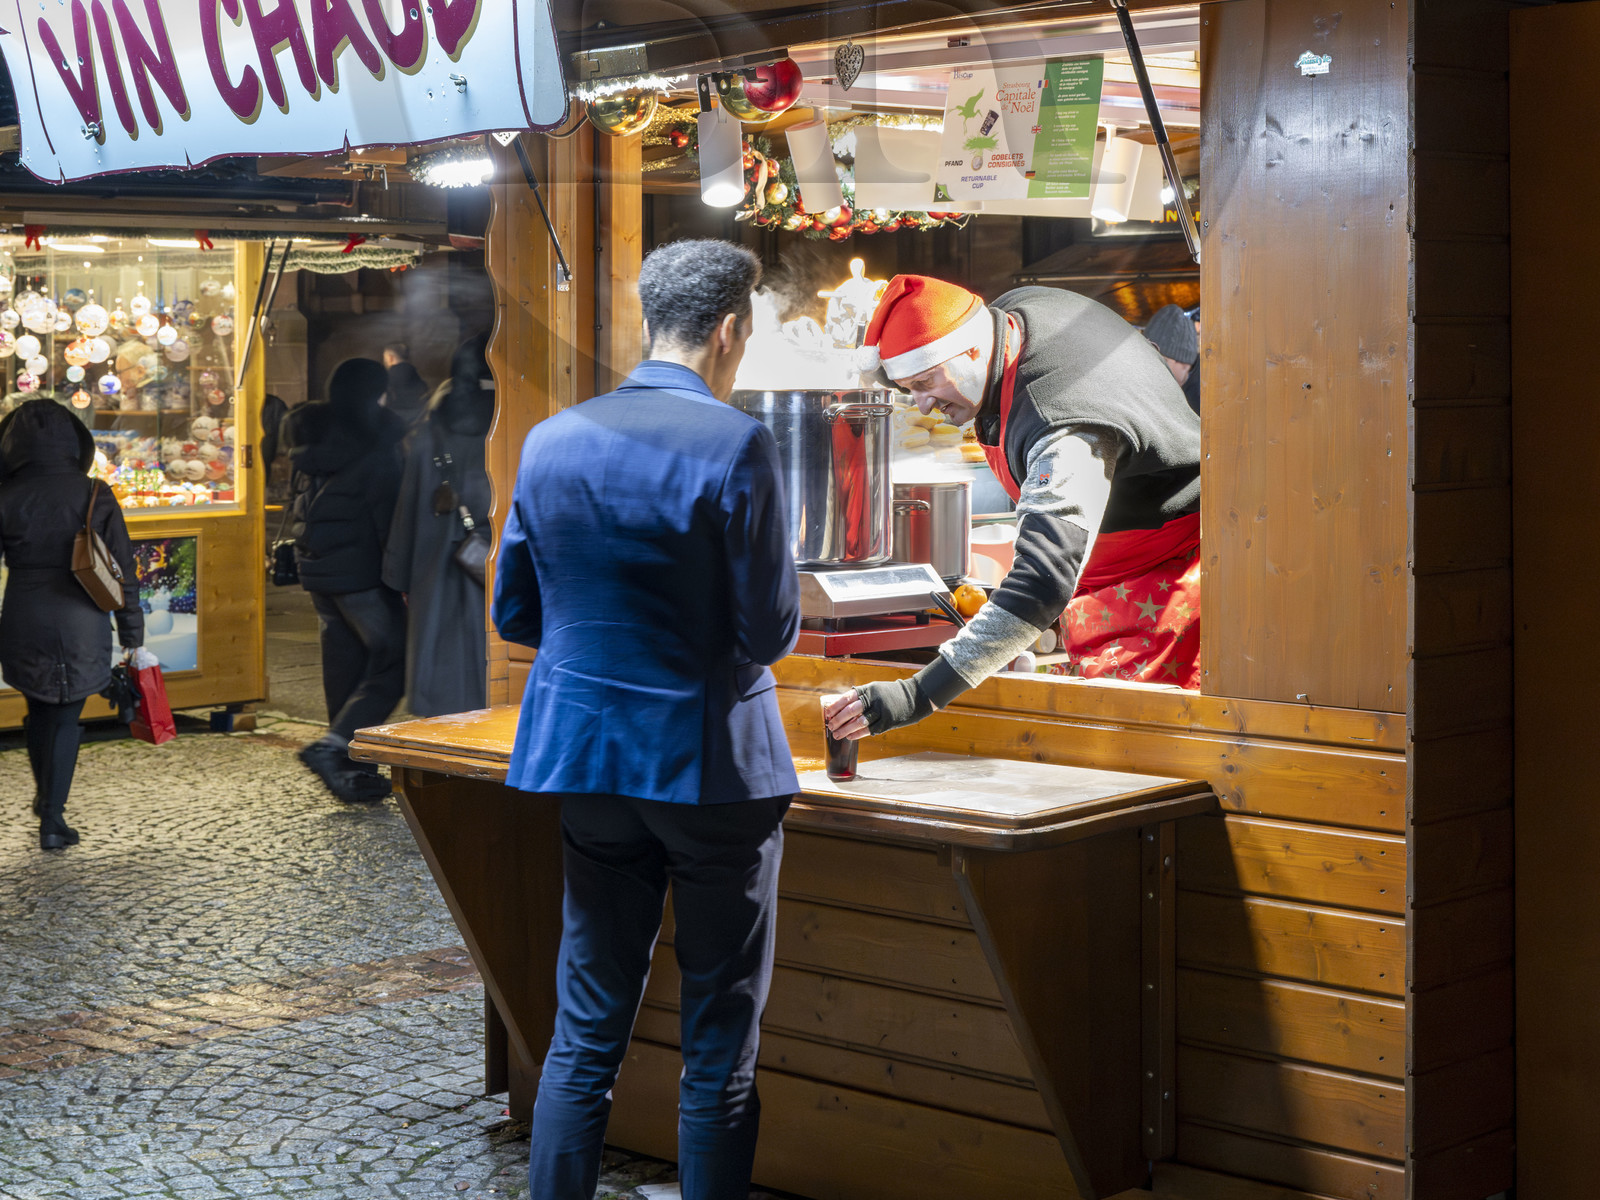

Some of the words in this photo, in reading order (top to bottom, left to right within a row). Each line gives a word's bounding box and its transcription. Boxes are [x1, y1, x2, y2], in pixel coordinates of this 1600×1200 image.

[995, 88, 1036, 104] Capitale
[1010, 101, 1035, 114] Noël
[991, 152, 1024, 161] GOBELETS
[944, 159, 964, 167] PFAND
[961, 174, 998, 182] RETURNABLE
